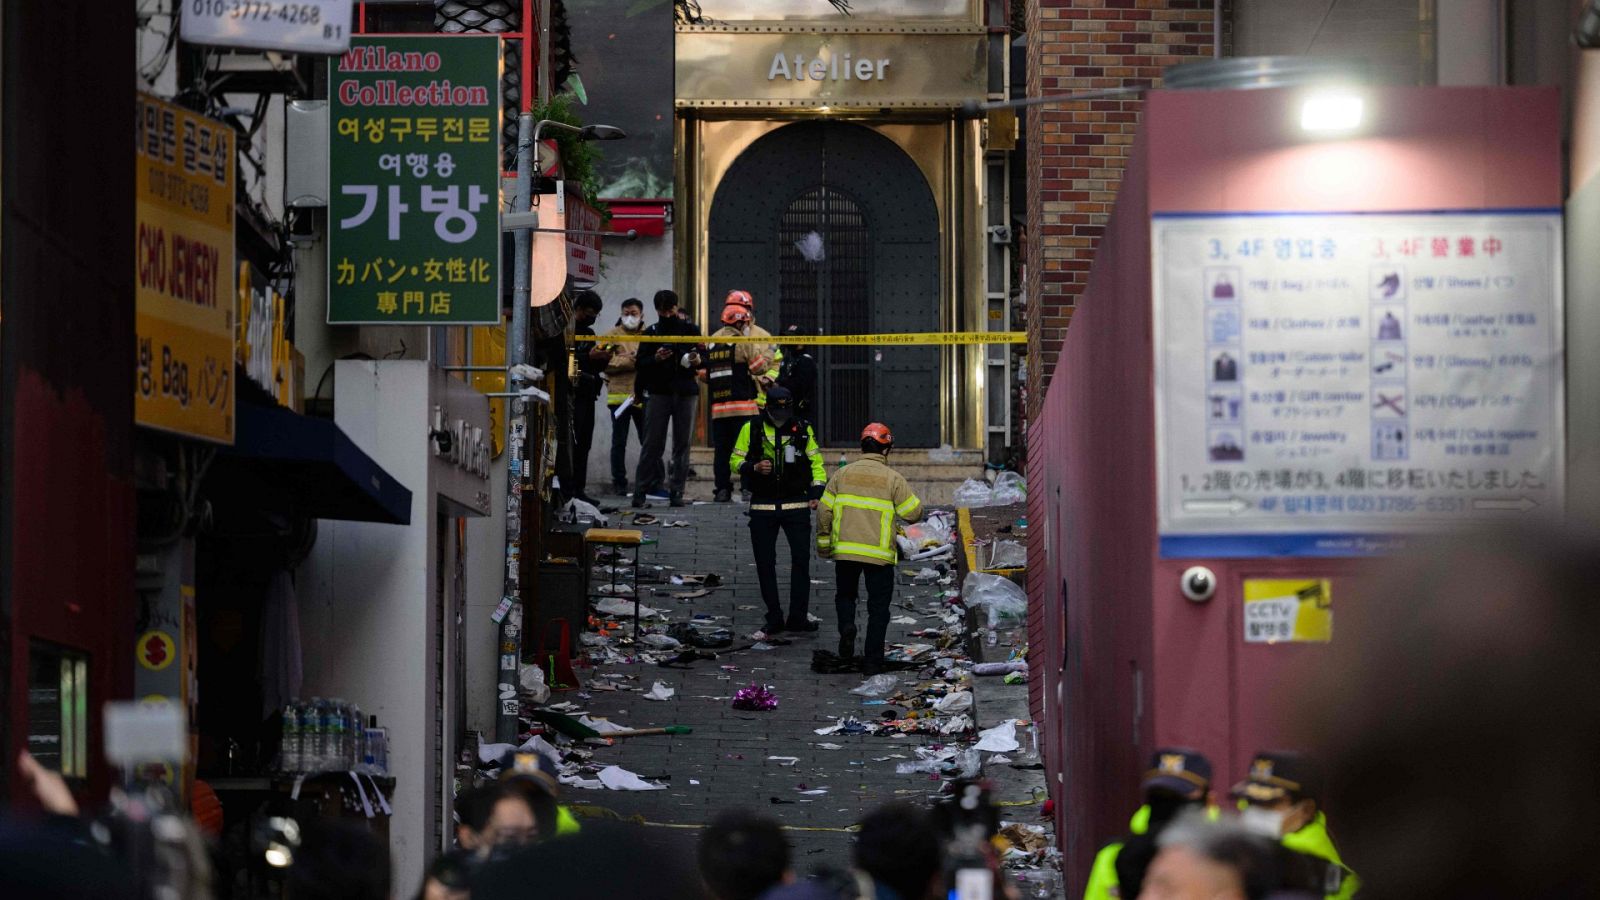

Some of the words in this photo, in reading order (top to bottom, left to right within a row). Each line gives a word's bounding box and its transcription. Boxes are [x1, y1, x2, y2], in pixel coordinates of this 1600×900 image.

[323, 25, 342, 39] B1
[338, 45, 441, 72] Milano
[767, 52, 890, 81] Atelier
[338, 80, 489, 106] Collection
[338, 118, 490, 143] 여성구두전문
[379, 153, 456, 178] 여행용
[341, 185, 489, 243] 가방
[337, 257, 490, 285] カバン・女性化
[1248, 603, 1290, 618] CCTV
